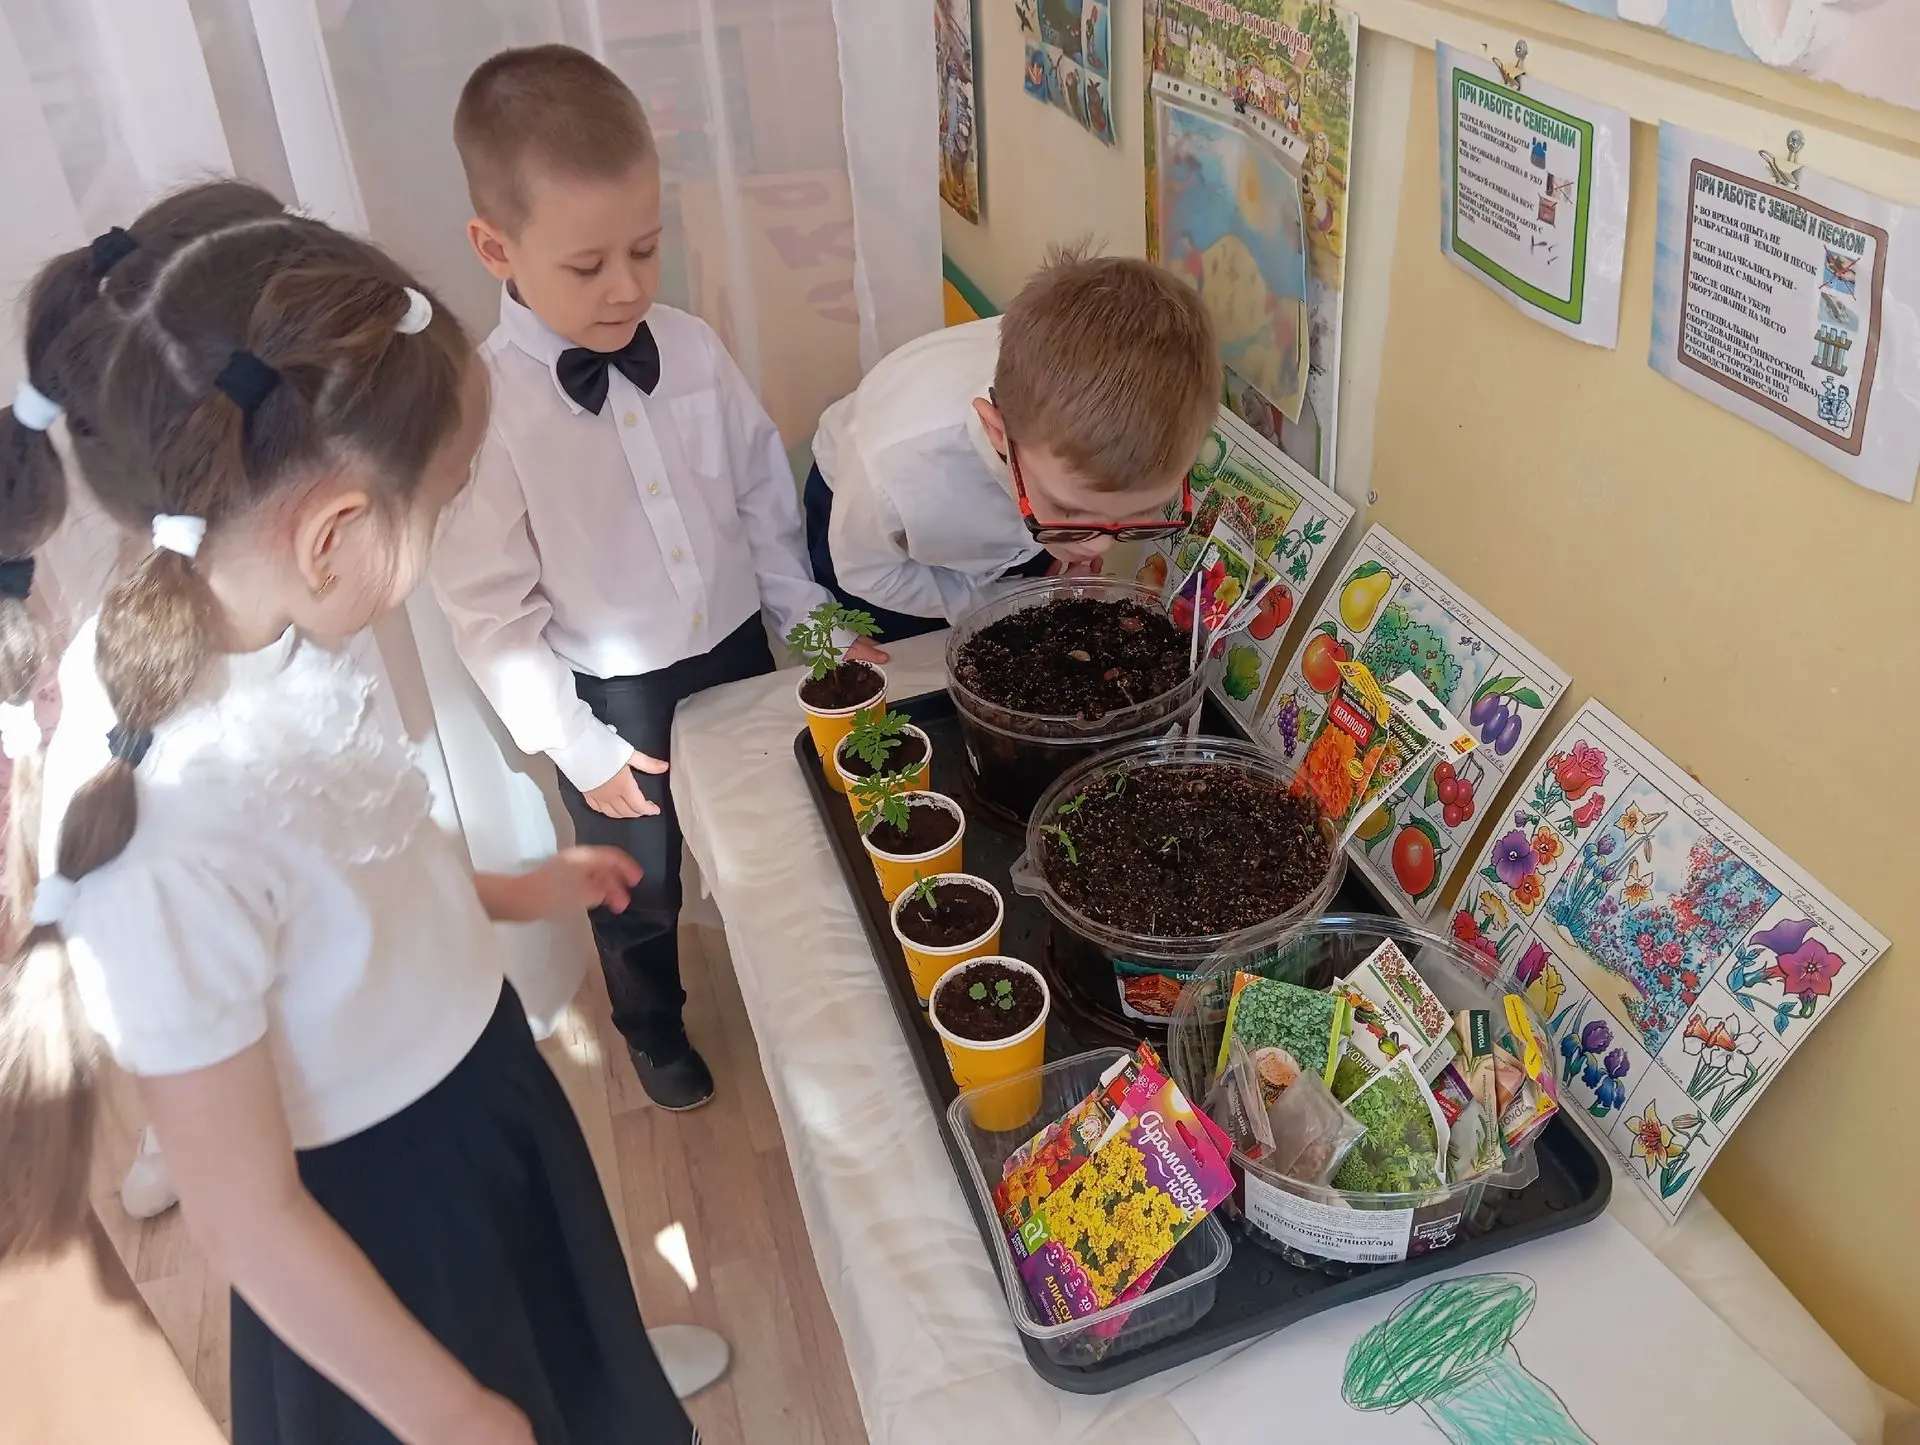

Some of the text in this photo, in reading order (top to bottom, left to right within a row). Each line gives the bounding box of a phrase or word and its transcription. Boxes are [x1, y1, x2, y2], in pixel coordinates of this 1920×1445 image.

[1243, 10, 1312, 61] природы
[1459, 81, 1576, 149] ПРИ РАБОТЕ С СЕМЕНАМИ
[1459, 120, 1517, 154] НАДЕНЬ СПЕЦОДЕЖДУ
[1478, 119, 1506, 139] НАЧАЛОМ
[1506, 132, 1529, 150] РАБОТЫ
[1468, 141, 1500, 165] ЗАСОВЫВАЙ
[1500, 158, 1523, 177] СЕМЕНА
[1529, 173, 1542, 186] УХО
[1469, 152, 1480, 164] НОС
[1467, 168, 1488, 186] ПРОБУЙ
[1488, 180, 1510, 198] СЕМЕНА
[1510, 192, 1518, 203] НА
[1519, 197, 1534, 211] ВКУС
[1471, 189, 1504, 213] ОСТОРОЖЕН
[1504, 207, 1515, 219] ПРИ
[1515, 214, 1537, 232] РАБОТЕ
[1537, 226, 1543, 235] С
[1481, 212, 1491, 224] ДЛЯ
[1491, 218, 1520, 242] РЫХЛЕНИЯ
[1695, 171, 1715, 196] ПРИ
[1716, 179, 1757, 212] РАБОТЕ
[1757, 195, 1767, 215] С
[1807, 215, 1816, 237] И
[1817, 219, 1866, 257] ПЕСКОМ
[1699, 205, 1781, 245] ВО ВРЕМЯ ОПЫТА НЕ
[1693, 212, 1817, 276] РАЗБРАСЫВАЙ ЗЕМЛЮ И ПЕСОК
[1694, 238, 1715, 254] ЕСЛИ
[1716, 247, 1772, 279] ЗАПАЧКАЛИСЬ
[1772, 272, 1793, 289] РУКИ
[1692, 249, 1772, 294] ВЫМОЙ ИХ С МЫЛОМ
[1692, 270, 1771, 315] ПОСЛЕ ОПЫТА УБЕРИ
[1688, 280, 1787, 335] ОБОРУДОВАНИЕ НА МЕСТО
[1689, 303, 1759, 345] СО СПЕЦИАЛЬНЫМ
[1684, 331, 1790, 395] РАБОТАЙ ОСТОРОЖНО И ПОД
[1685, 321, 1732, 353] СТЕКЛЯННАЯ
[1732, 346, 1766, 371] ПОСУДА,
[1686, 311, 1806, 381] ОБОРУДОВАНИЕМ (МИКРОСКОП,
[1684, 342, 1788, 403] РУКОВОДСТВОМ ВЗРОСЛОГО
[1333, 704, 1368, 739] ЛИМПОПО
[1476, 1014, 1486, 1049] РОЗМАРИН
[1138, 1111, 1209, 1212] Ароматы
[1045, 1275, 1074, 1321] АЛИССУ
[1081, 1295, 1092, 1311] 20
